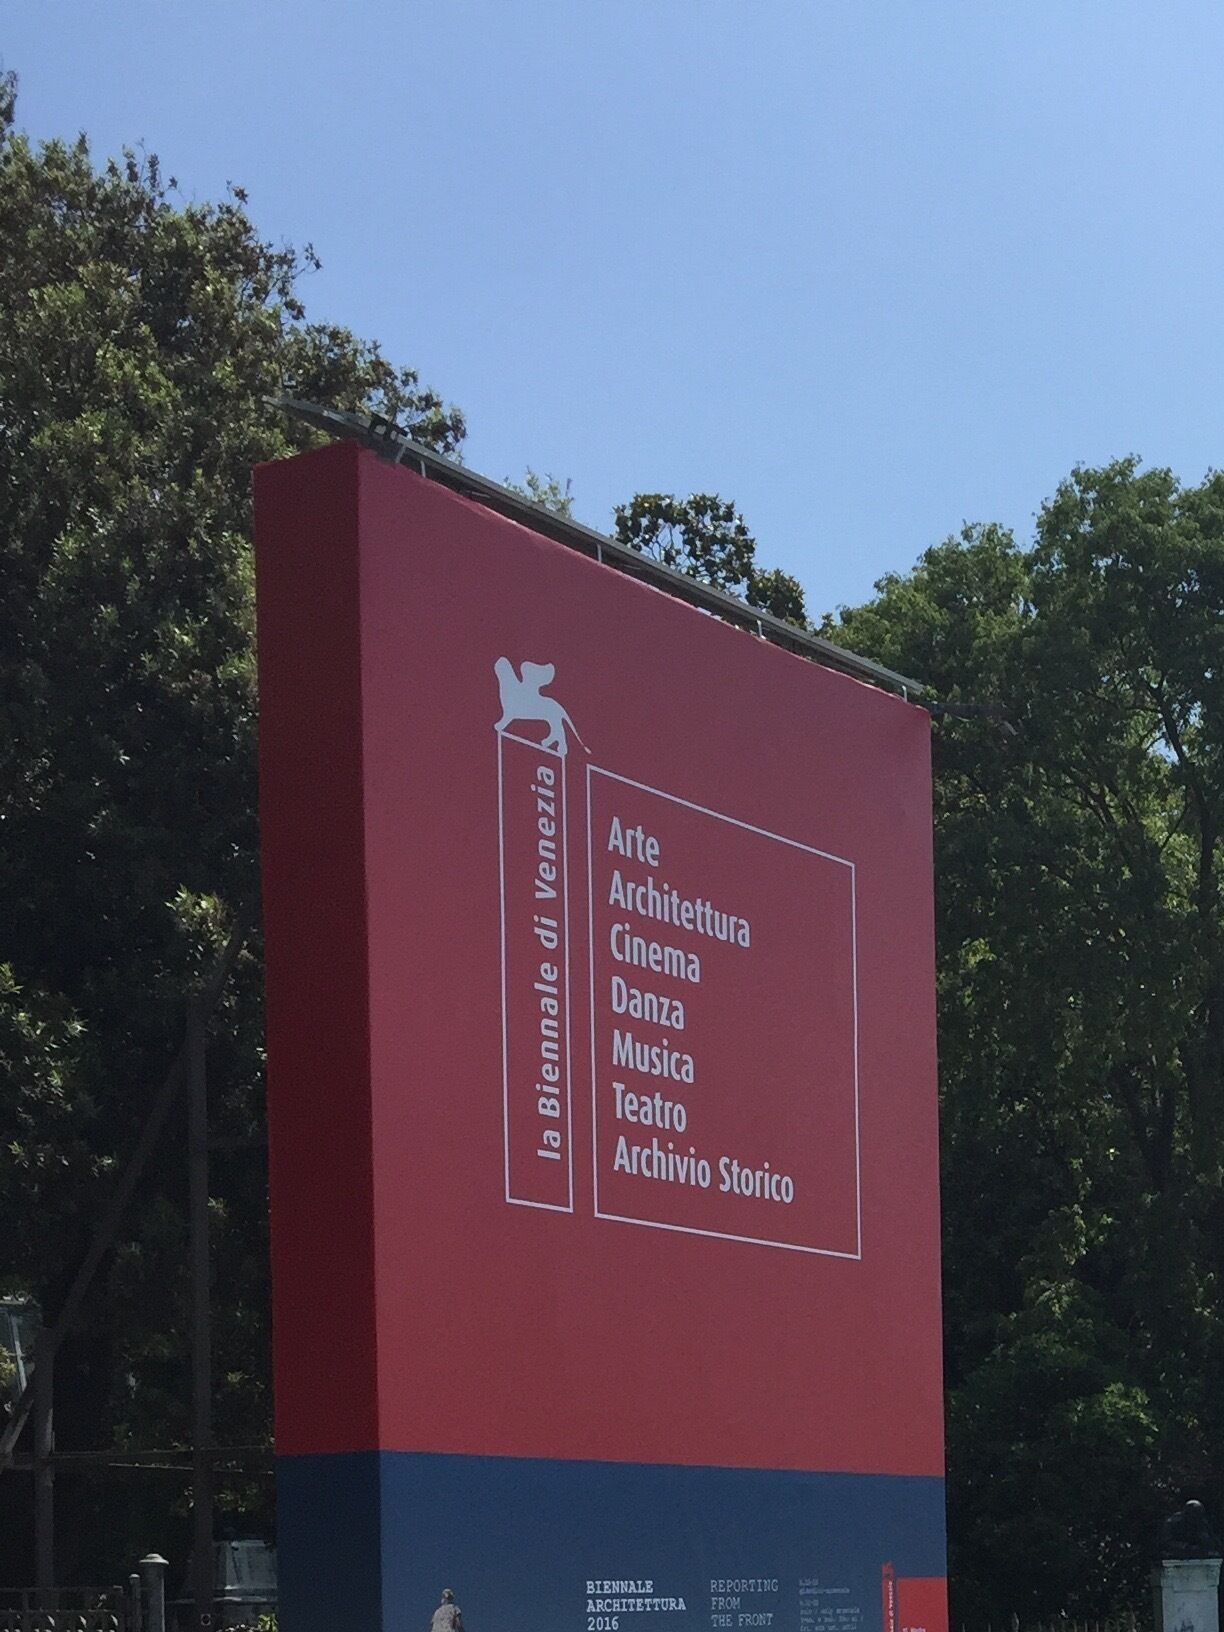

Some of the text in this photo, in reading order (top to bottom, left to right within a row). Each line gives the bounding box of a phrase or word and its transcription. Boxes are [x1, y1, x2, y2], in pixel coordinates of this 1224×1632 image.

[607, 816, 660, 867] Arte
[608, 869, 750, 948] Architettura
[531, 765, 561, 1160] la Biennale di Venezia
[610, 922, 700, 983] Cinema
[611, 975, 684, 1030] Danza
[612, 1029, 694, 1084] Musica
[612, 1081, 687, 1133] Teatro
[613, 1135, 794, 1204] Archivio Storico
[586, 1580, 654, 1594] BIENNALE
[586, 1597, 687, 1613] ARCHITETTURA
[710, 1579, 779, 1593] REPORTING
[711, 1597, 741, 1610] FROM
[587, 1616, 619, 1631] 2016
[711, 1613, 773, 1627] THE FRONT
